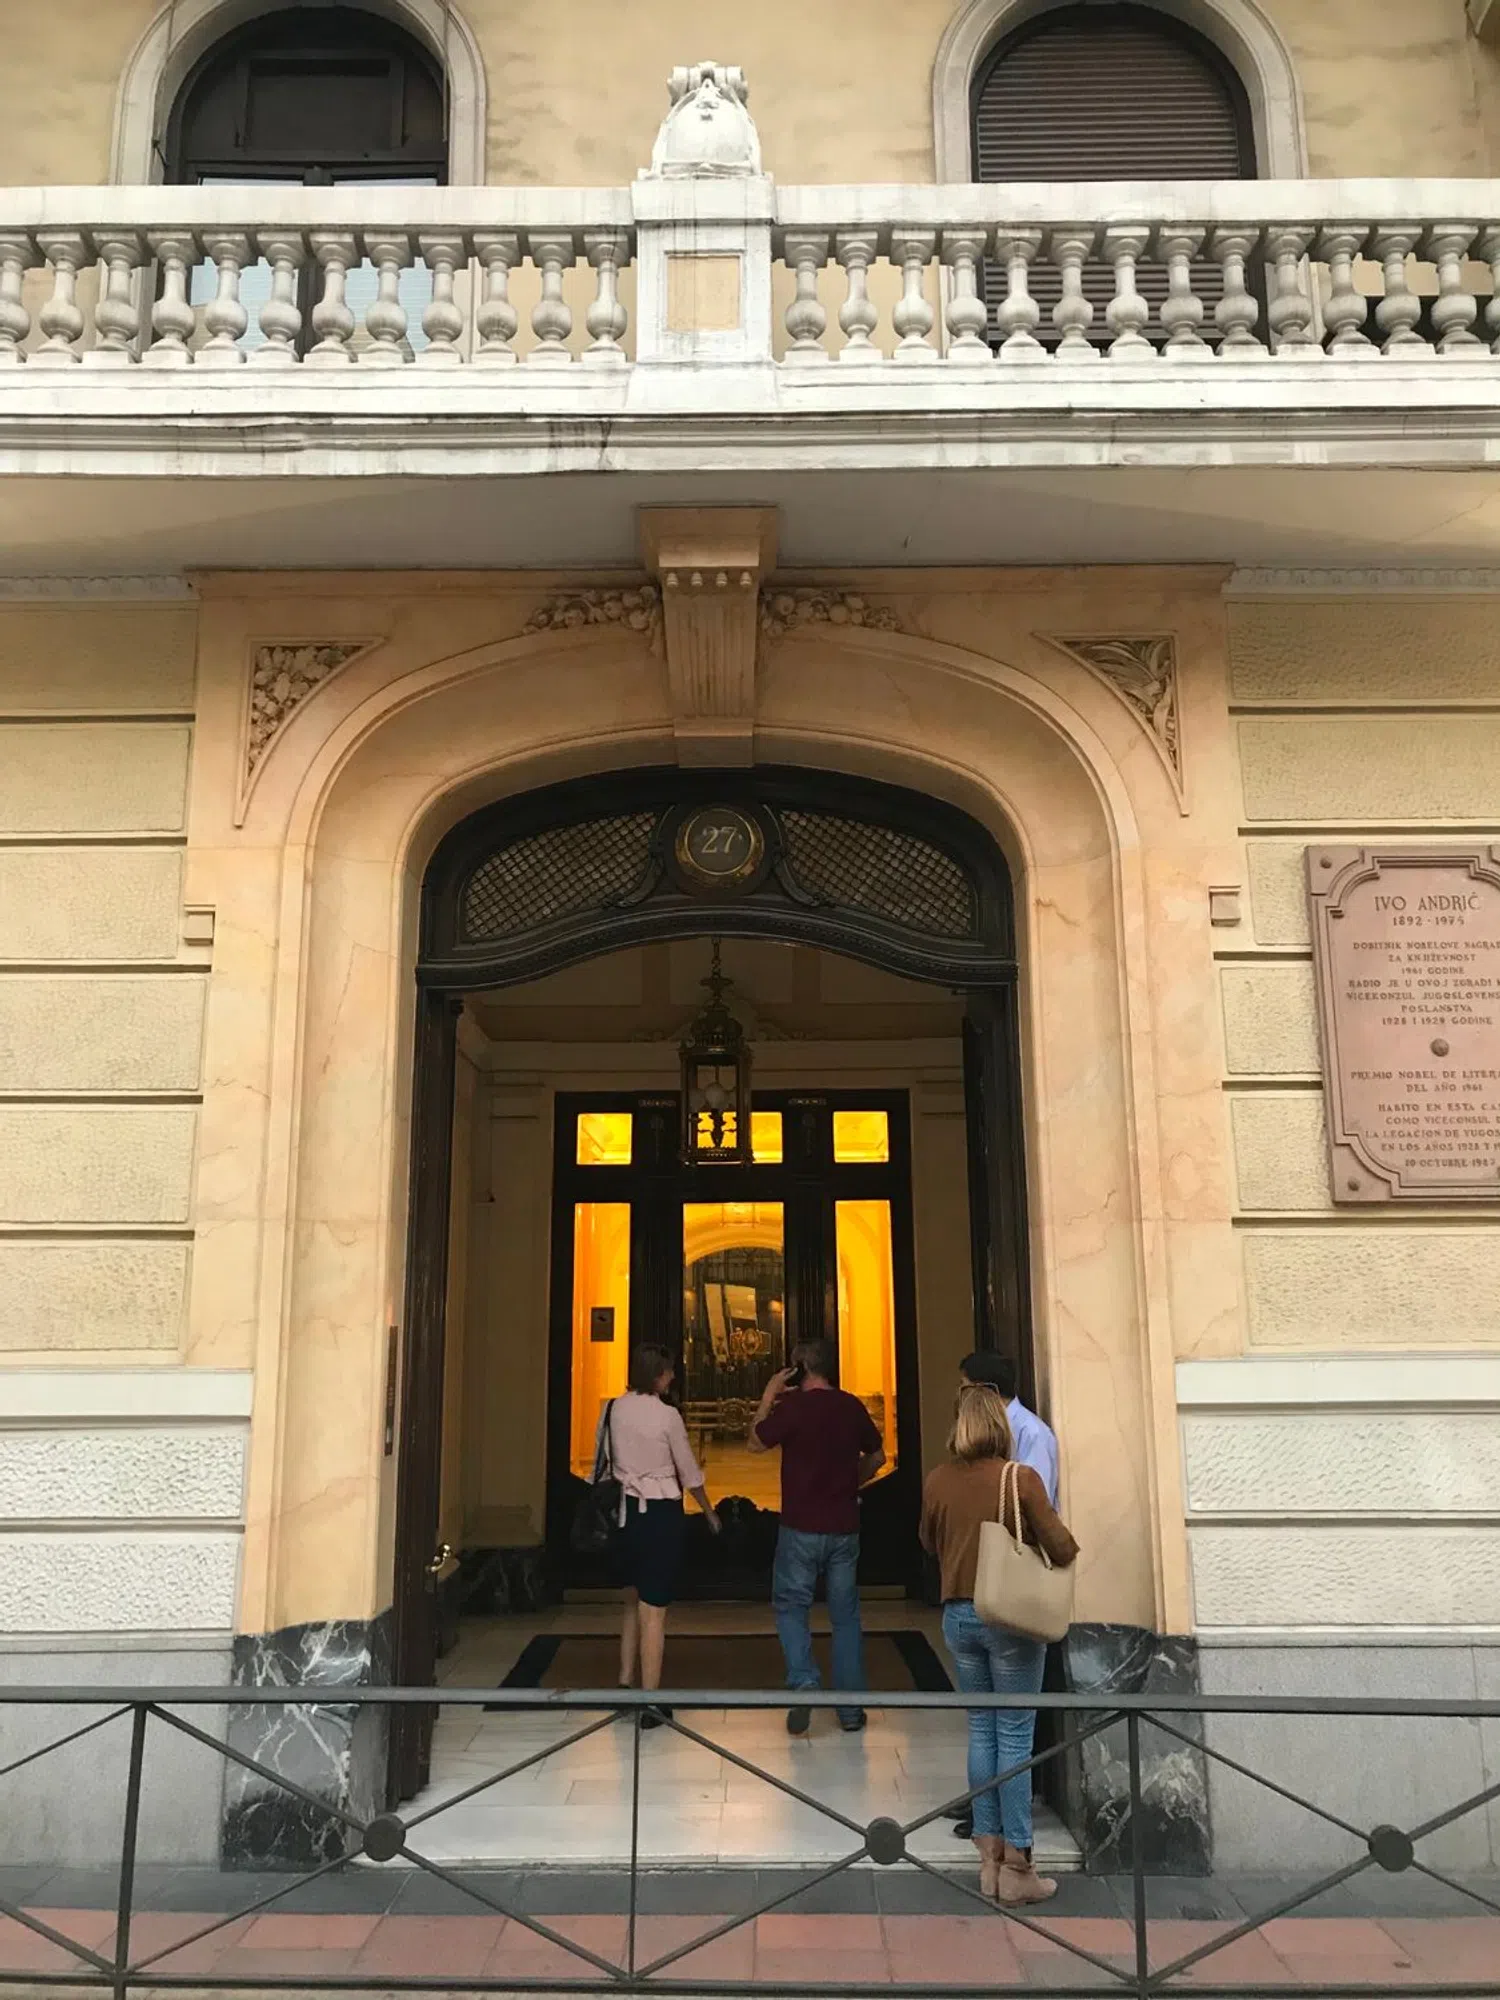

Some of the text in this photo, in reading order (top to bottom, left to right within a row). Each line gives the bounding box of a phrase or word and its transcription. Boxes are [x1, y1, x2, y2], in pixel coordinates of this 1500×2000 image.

[702, 826, 737, 854] 27
[1374, 895, 1407, 911] IVO
[1393, 916, 1423, 926] 1892
[1435, 916, 1465, 926] 1975
[1353, 941, 1401, 950] DOBITNIK
[1407, 941, 1460, 950] NOBELOVE
[1388, 953, 1402, 962] ZA
[1401, 966, 1465, 975] 1961 GODINE
[1348, 980, 1381, 988] RADIO
[1388, 979, 1400, 988] JE
[1406, 979, 1412, 988] U
[1417, 979, 1448, 988] OVOJ
[1453, 979, 1492, 988] ZGRADI
[1346, 991, 1415, 1000] VICEKONZUL
[1401, 1004, 1473, 1013] POSLANSTVA
[1382, 1016, 1407, 1025] 1928
[1450, 1016, 1493, 1025] GODINE
[1351, 1071, 1392, 1080] PREMIO
[1398, 1070, 1436, 1079] NOBEL
[1442, 1070, 1457, 1079] DE
[1406, 1082, 1483, 1093] DEL AÑO 1961
[1426, 1103, 1442, 1112] EN
[1447, 1103, 1475, 1112] ESTA
[1385, 1116, 1420, 1125] COMO
[1365, 1130, 1379, 1139] LA
[1445, 1129, 1460, 1139] DE
[1381, 1143, 1395, 1152] EN
[1399, 1143, 1421, 1152] LOS
[1457, 1142, 1480, 1152] 1928
[1419, 1159, 1468, 1168] OCTUBRE
